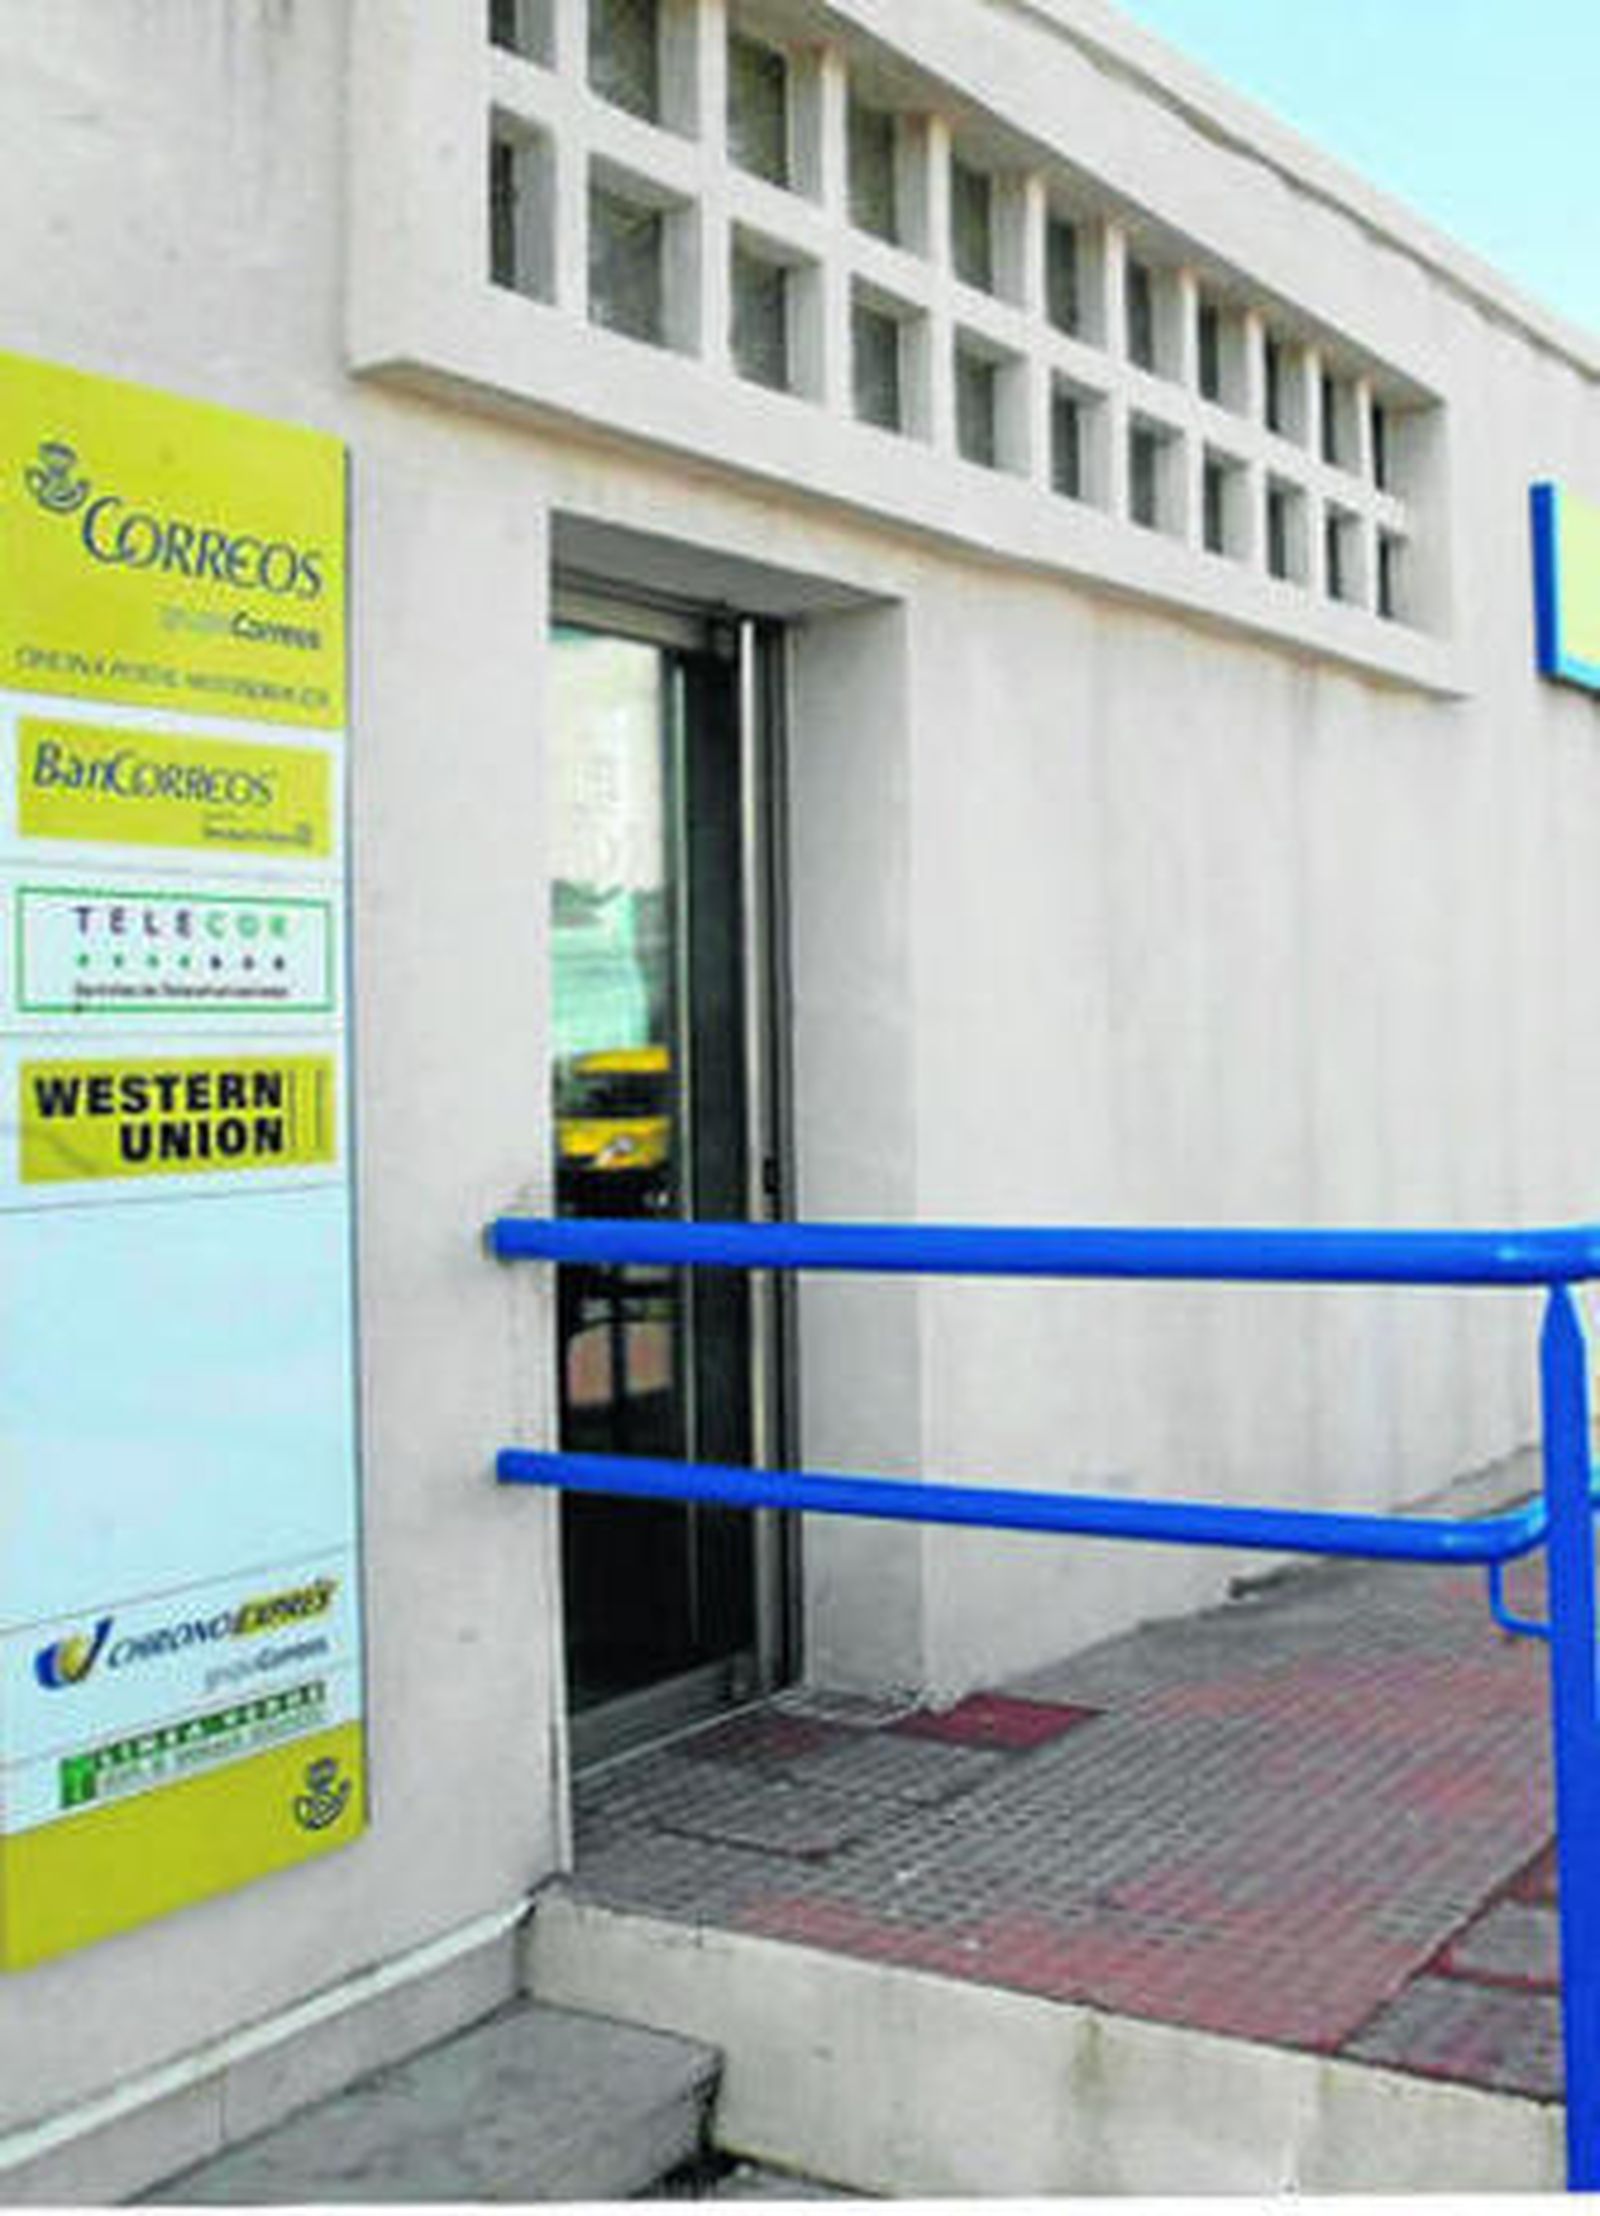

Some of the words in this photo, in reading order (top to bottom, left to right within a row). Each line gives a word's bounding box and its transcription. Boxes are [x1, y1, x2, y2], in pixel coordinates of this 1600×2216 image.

[82, 496, 323, 600] CORREOS
[35, 1071, 283, 1118] WESTERN
[120, 1117, 283, 1162] UNION
